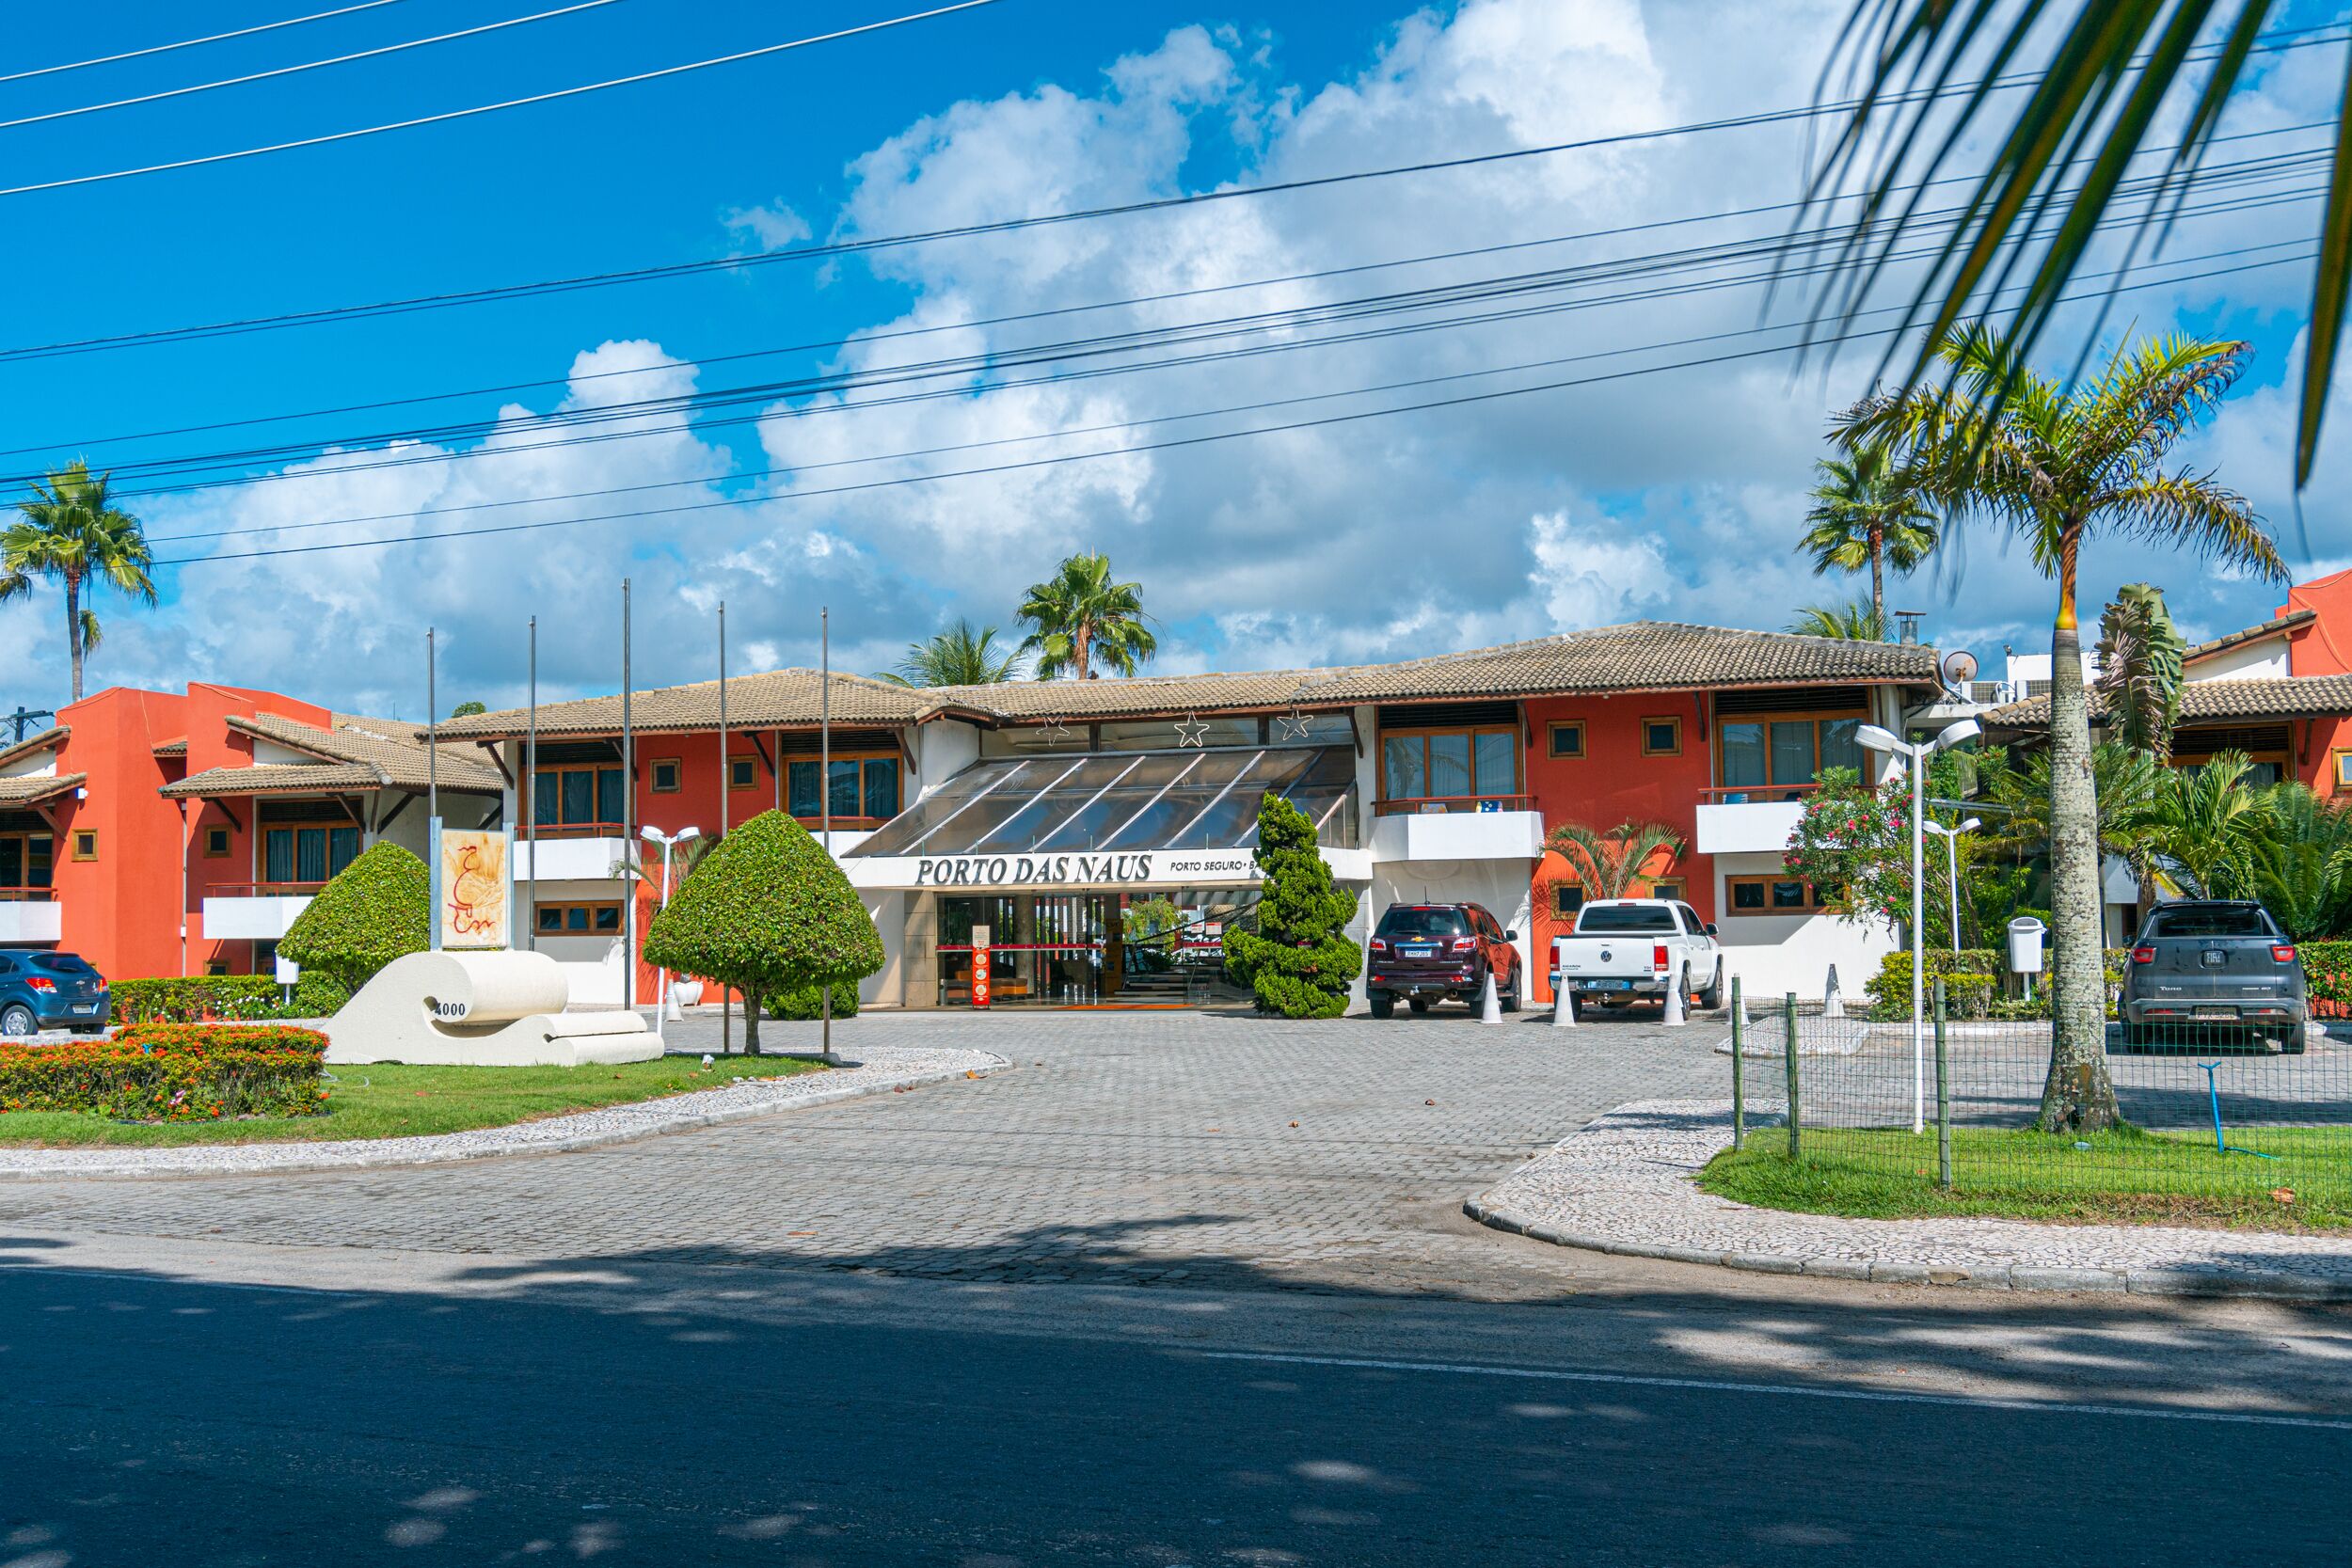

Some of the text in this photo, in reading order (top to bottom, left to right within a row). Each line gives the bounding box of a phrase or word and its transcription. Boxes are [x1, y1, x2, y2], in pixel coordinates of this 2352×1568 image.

[915, 854, 1152, 884] PORTO DAS NAUS
[1170, 862, 1201, 871] PORTO
[2206, 952, 2221, 963] FIAT
[435, 1003, 466, 1016] 4000
